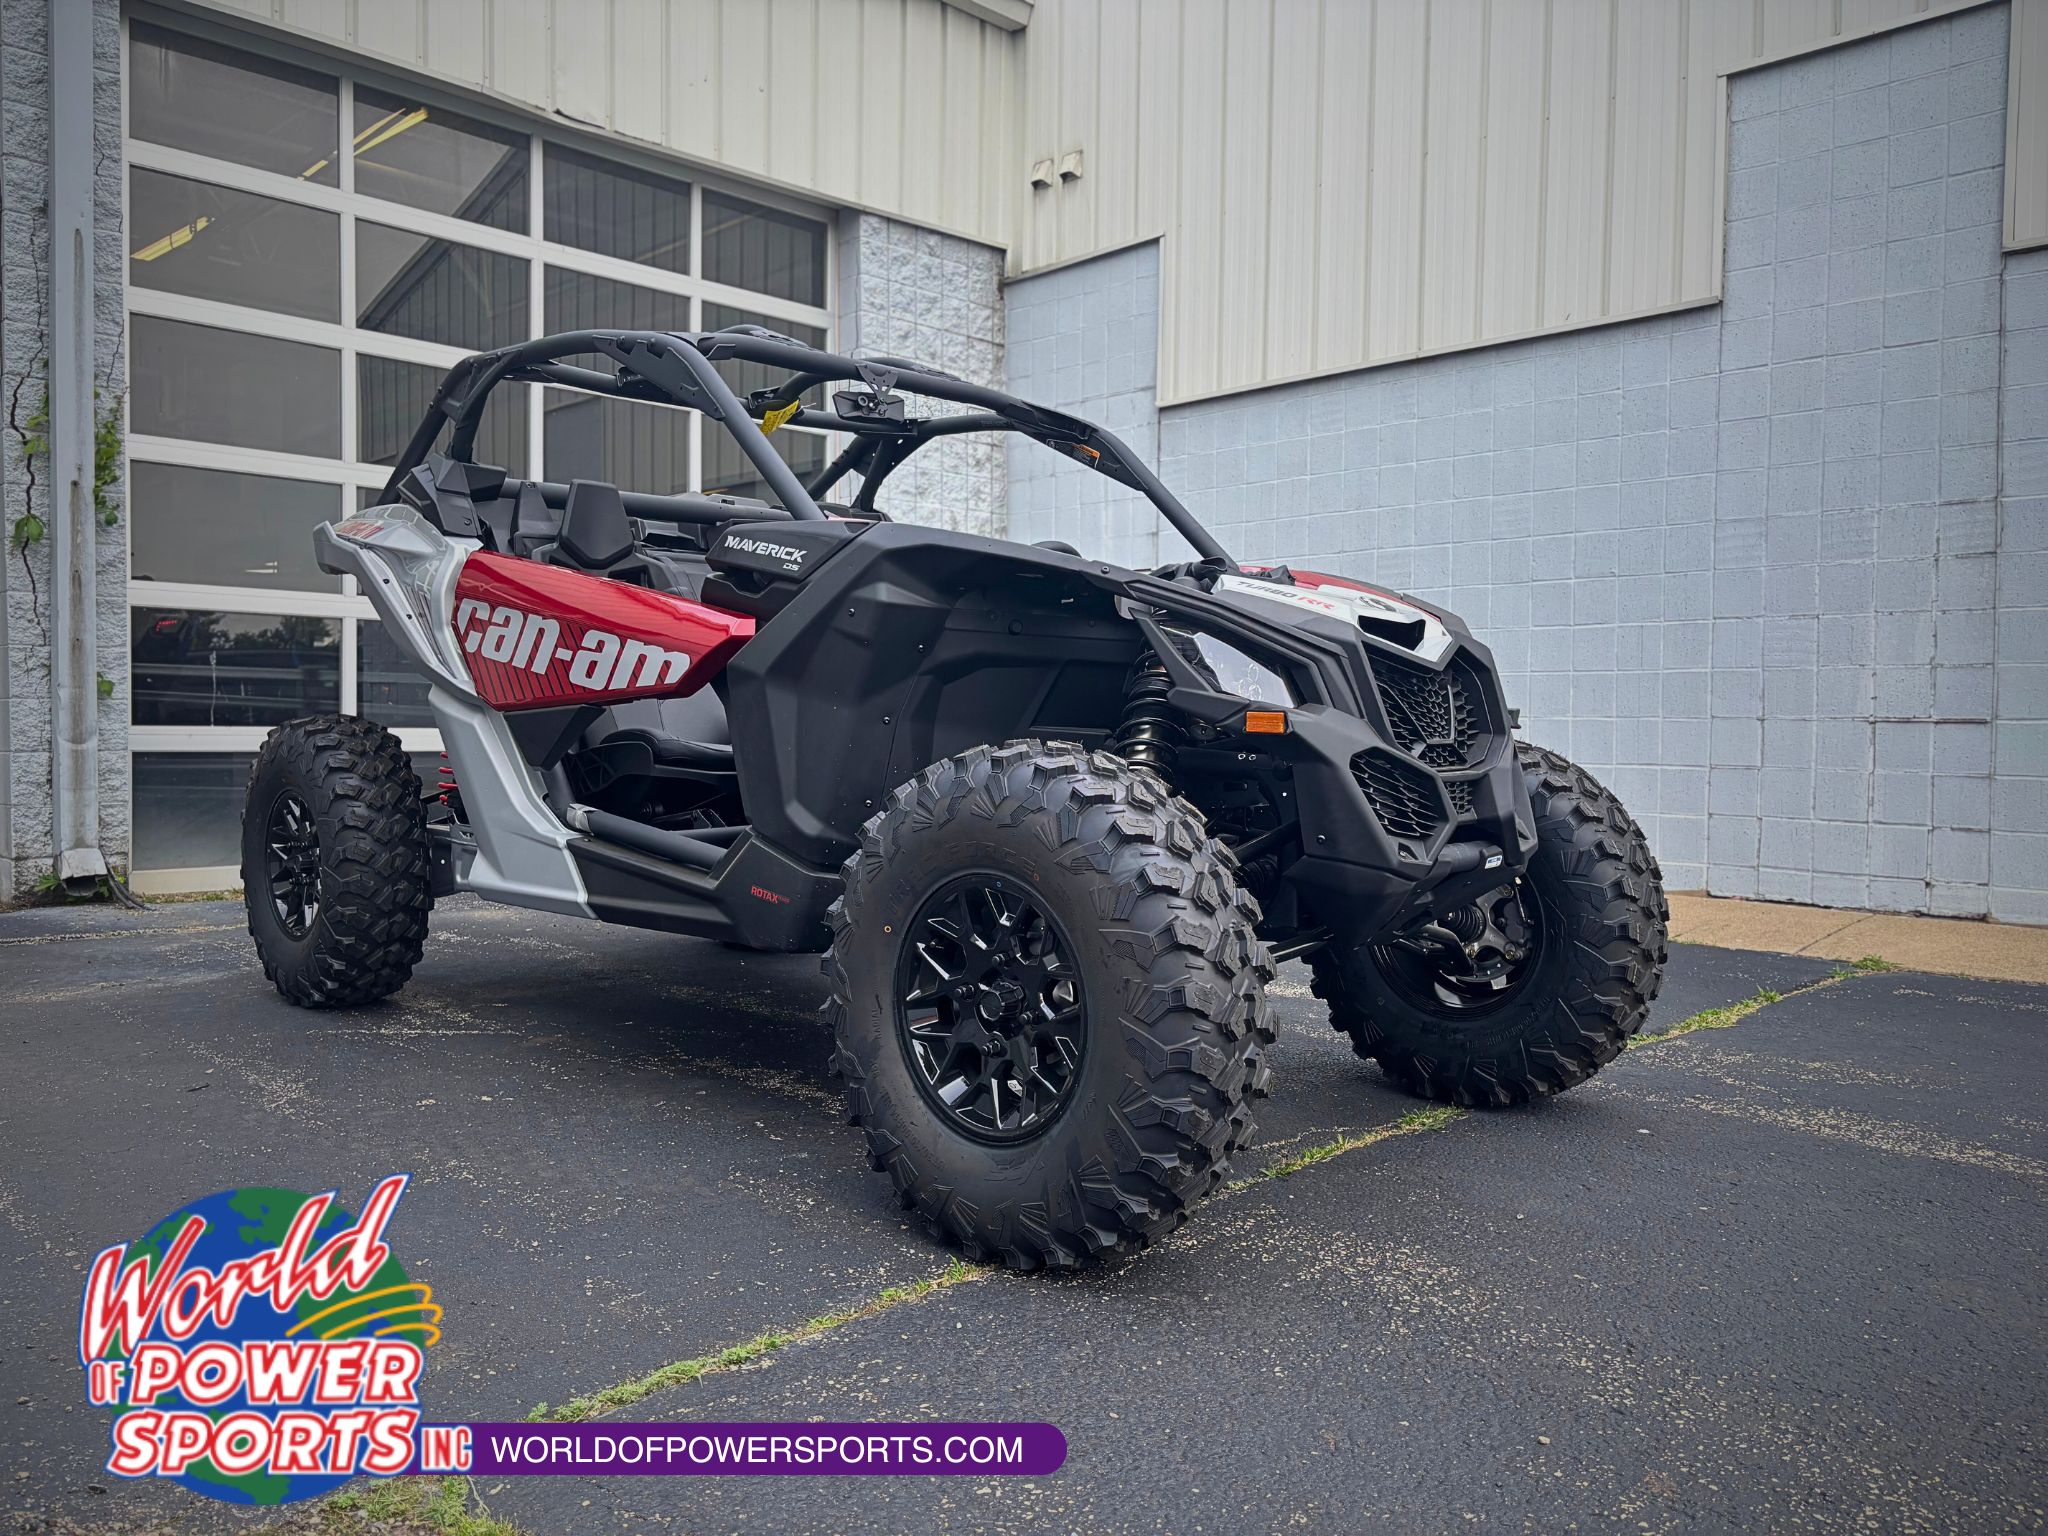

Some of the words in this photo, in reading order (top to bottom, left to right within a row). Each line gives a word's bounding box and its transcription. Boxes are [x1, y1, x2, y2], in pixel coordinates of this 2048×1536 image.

[724, 535, 807, 562] MAVERICK
[782, 562, 800, 571] DS
[1238, 581, 1297, 598] TURBO
[457, 597, 691, 691] can-am
[751, 885, 778, 904] ROTAX
